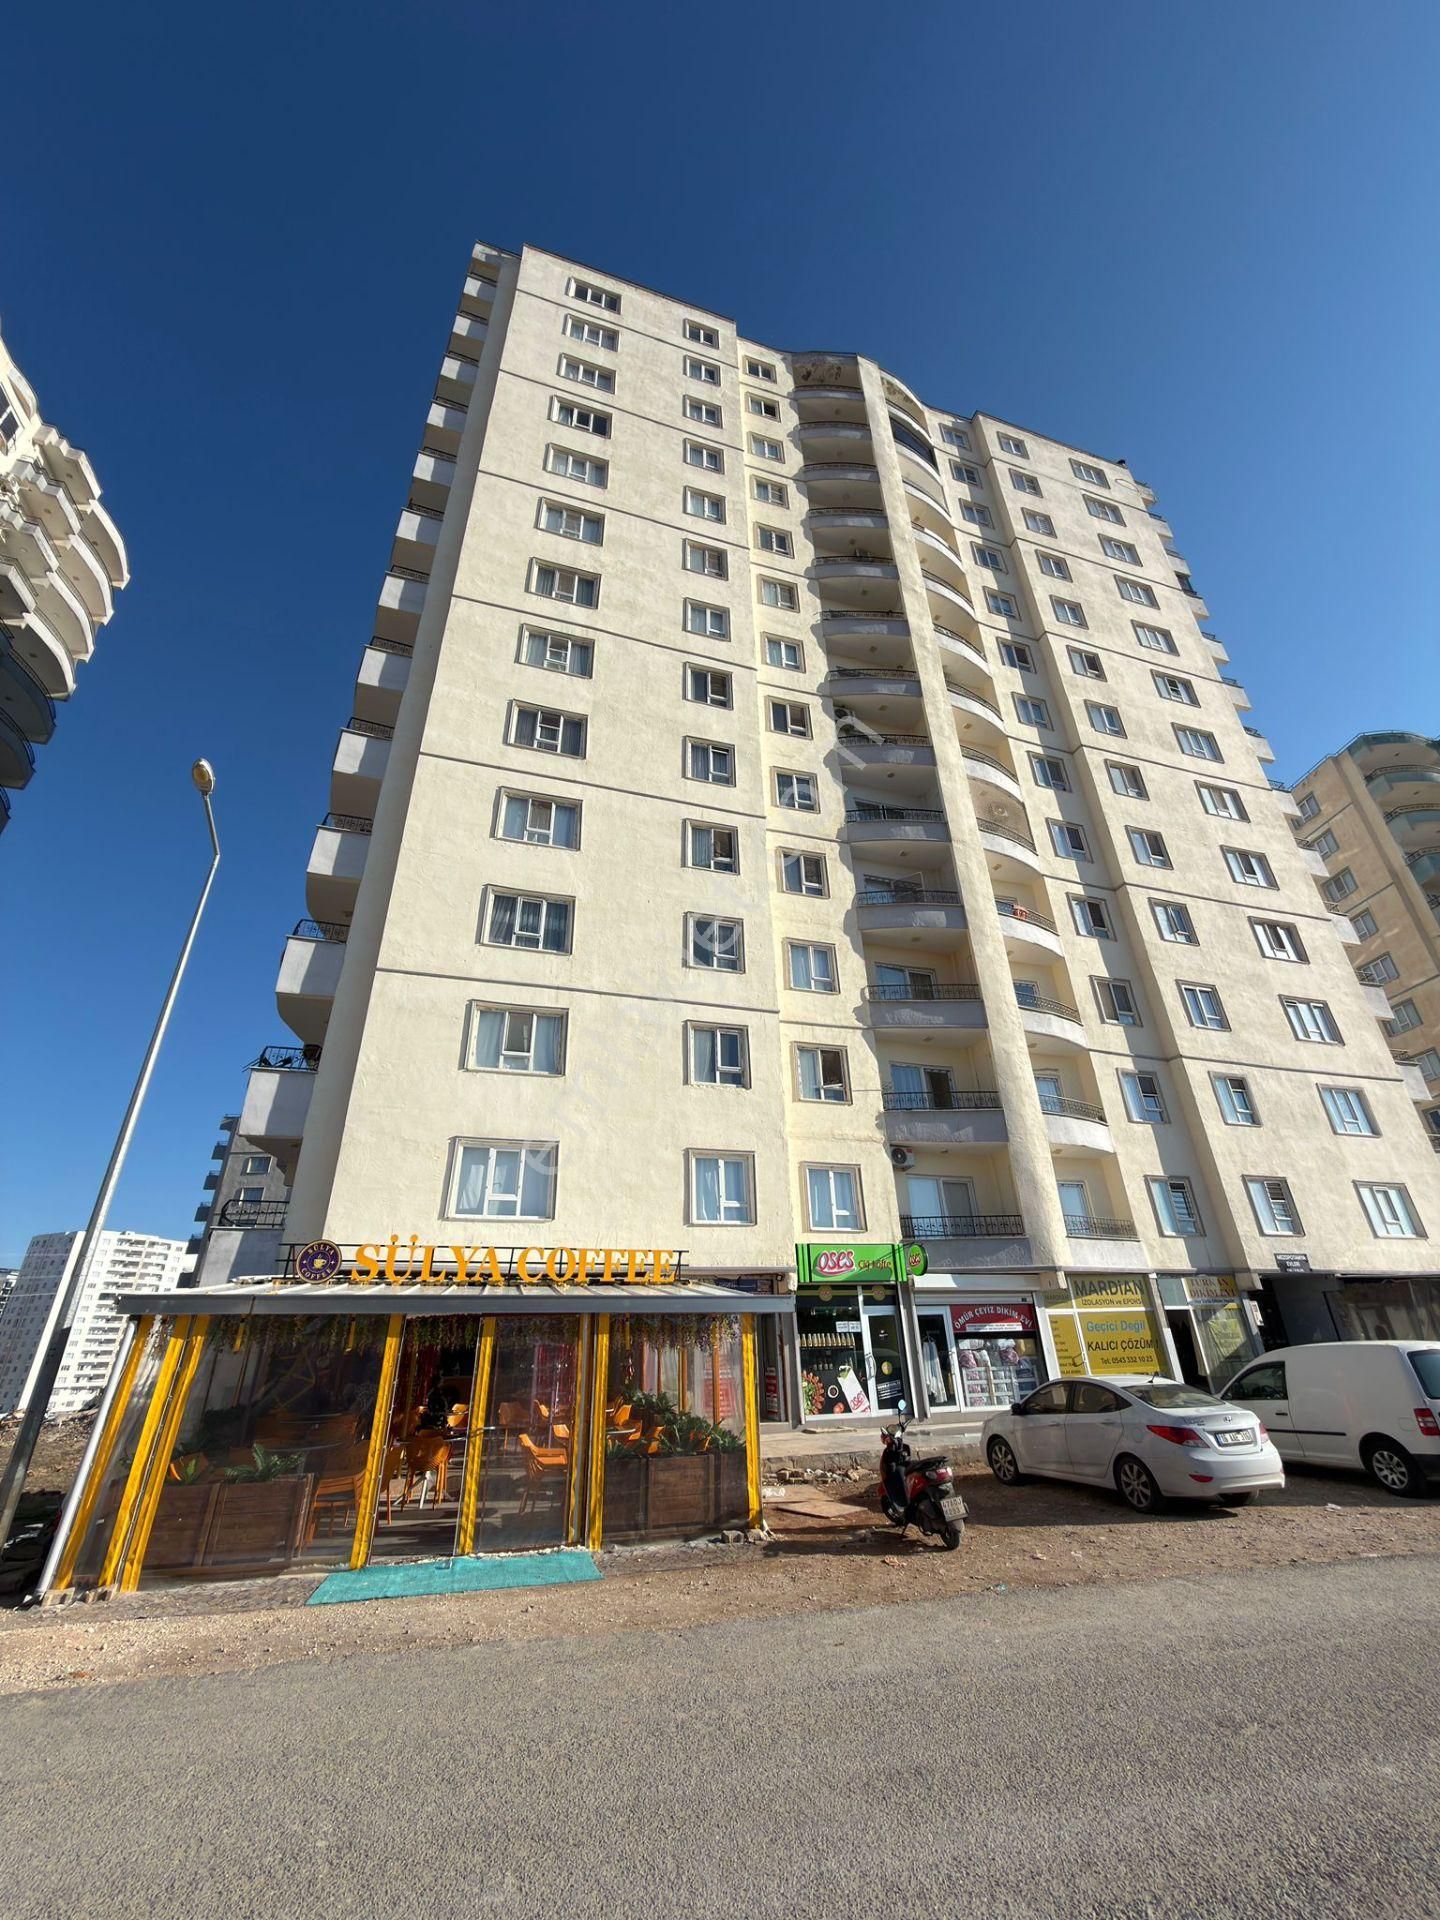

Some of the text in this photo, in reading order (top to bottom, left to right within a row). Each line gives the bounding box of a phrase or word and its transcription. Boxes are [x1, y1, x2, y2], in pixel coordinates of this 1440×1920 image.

[351, 1233, 678, 1283] SÜLYA COFFEE
[301, 1267, 333, 1280] COFFEE
[953, 1310, 975, 1330] ÖMÜR
[974, 1304, 995, 1318] ÇEYİZ
[1086, 1318, 1145, 1335] Geçici Değil
[1087, 1338, 1119, 1352] KALICI
